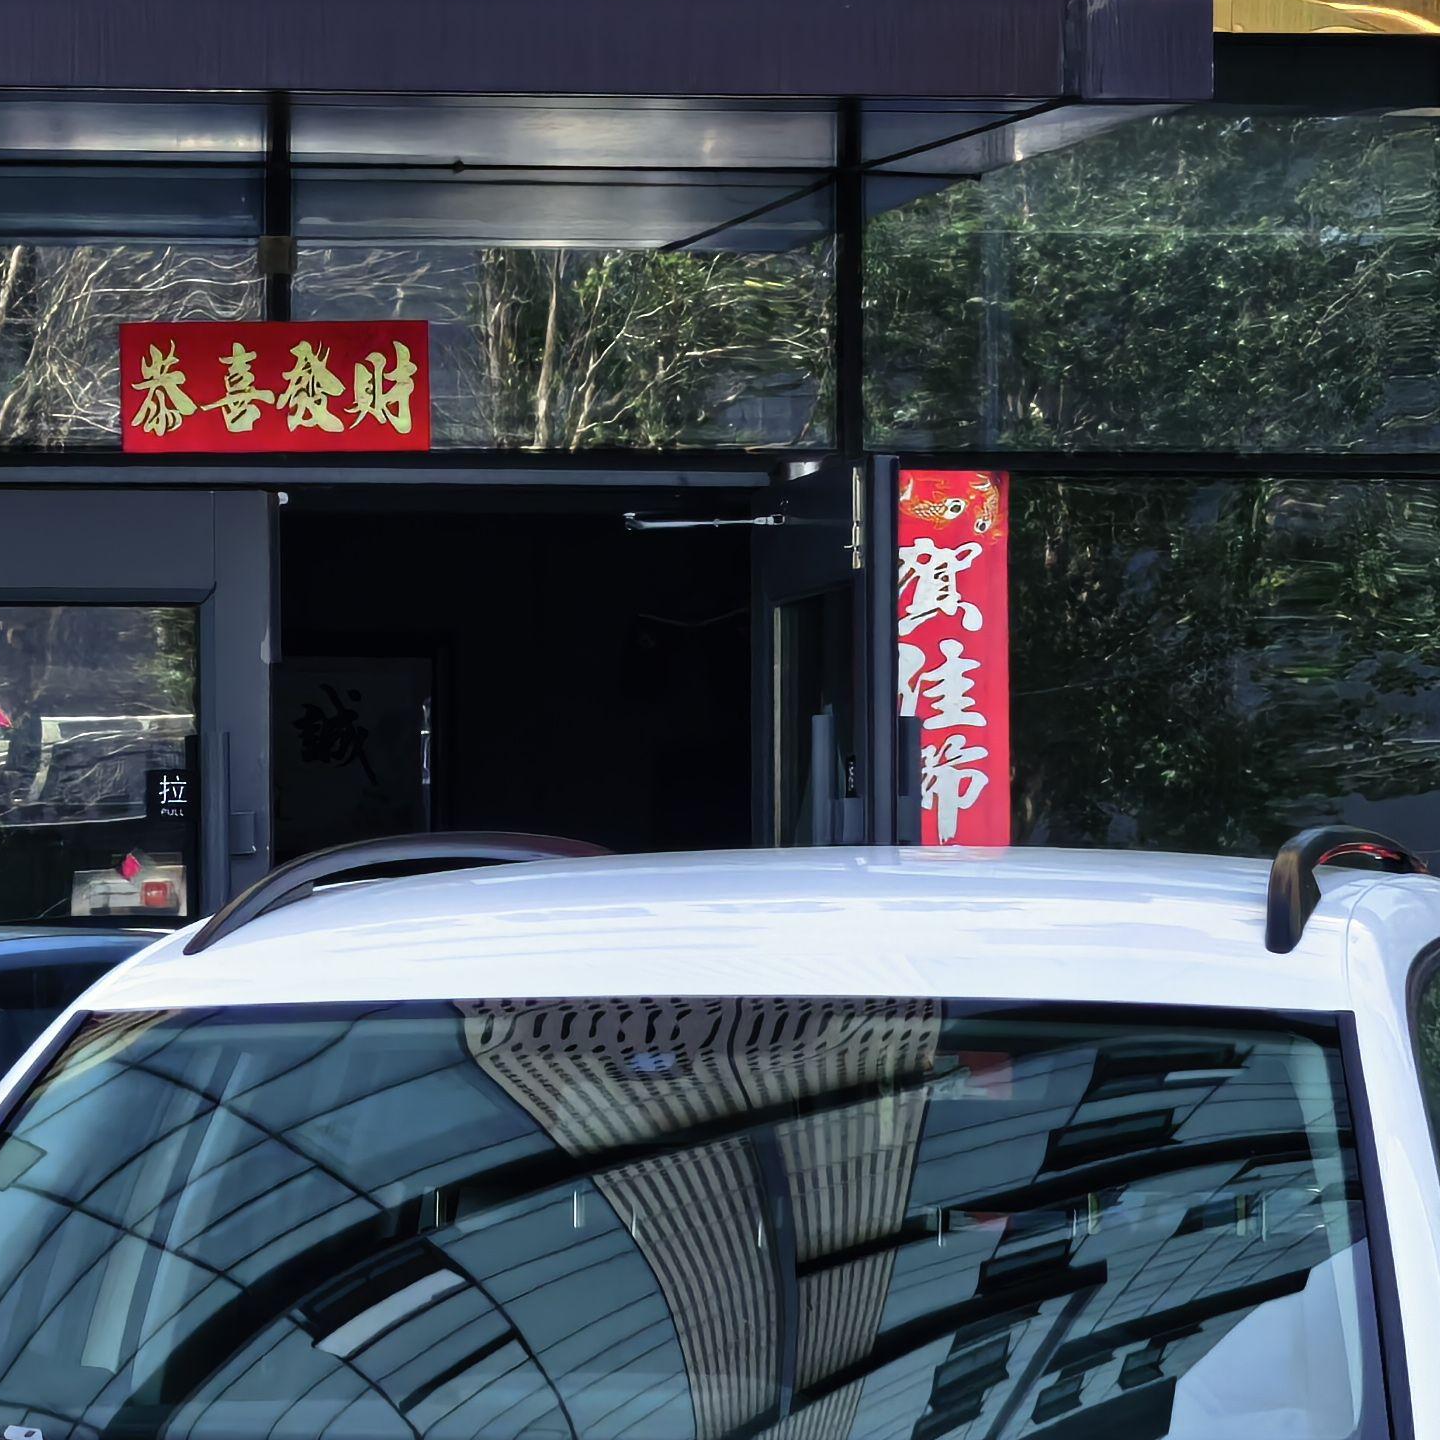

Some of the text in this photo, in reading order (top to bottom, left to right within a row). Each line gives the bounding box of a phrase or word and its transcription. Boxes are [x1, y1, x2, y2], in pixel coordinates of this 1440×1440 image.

[131, 339, 418, 437] 恭喜發財
[159, 774, 188, 805] 拉
